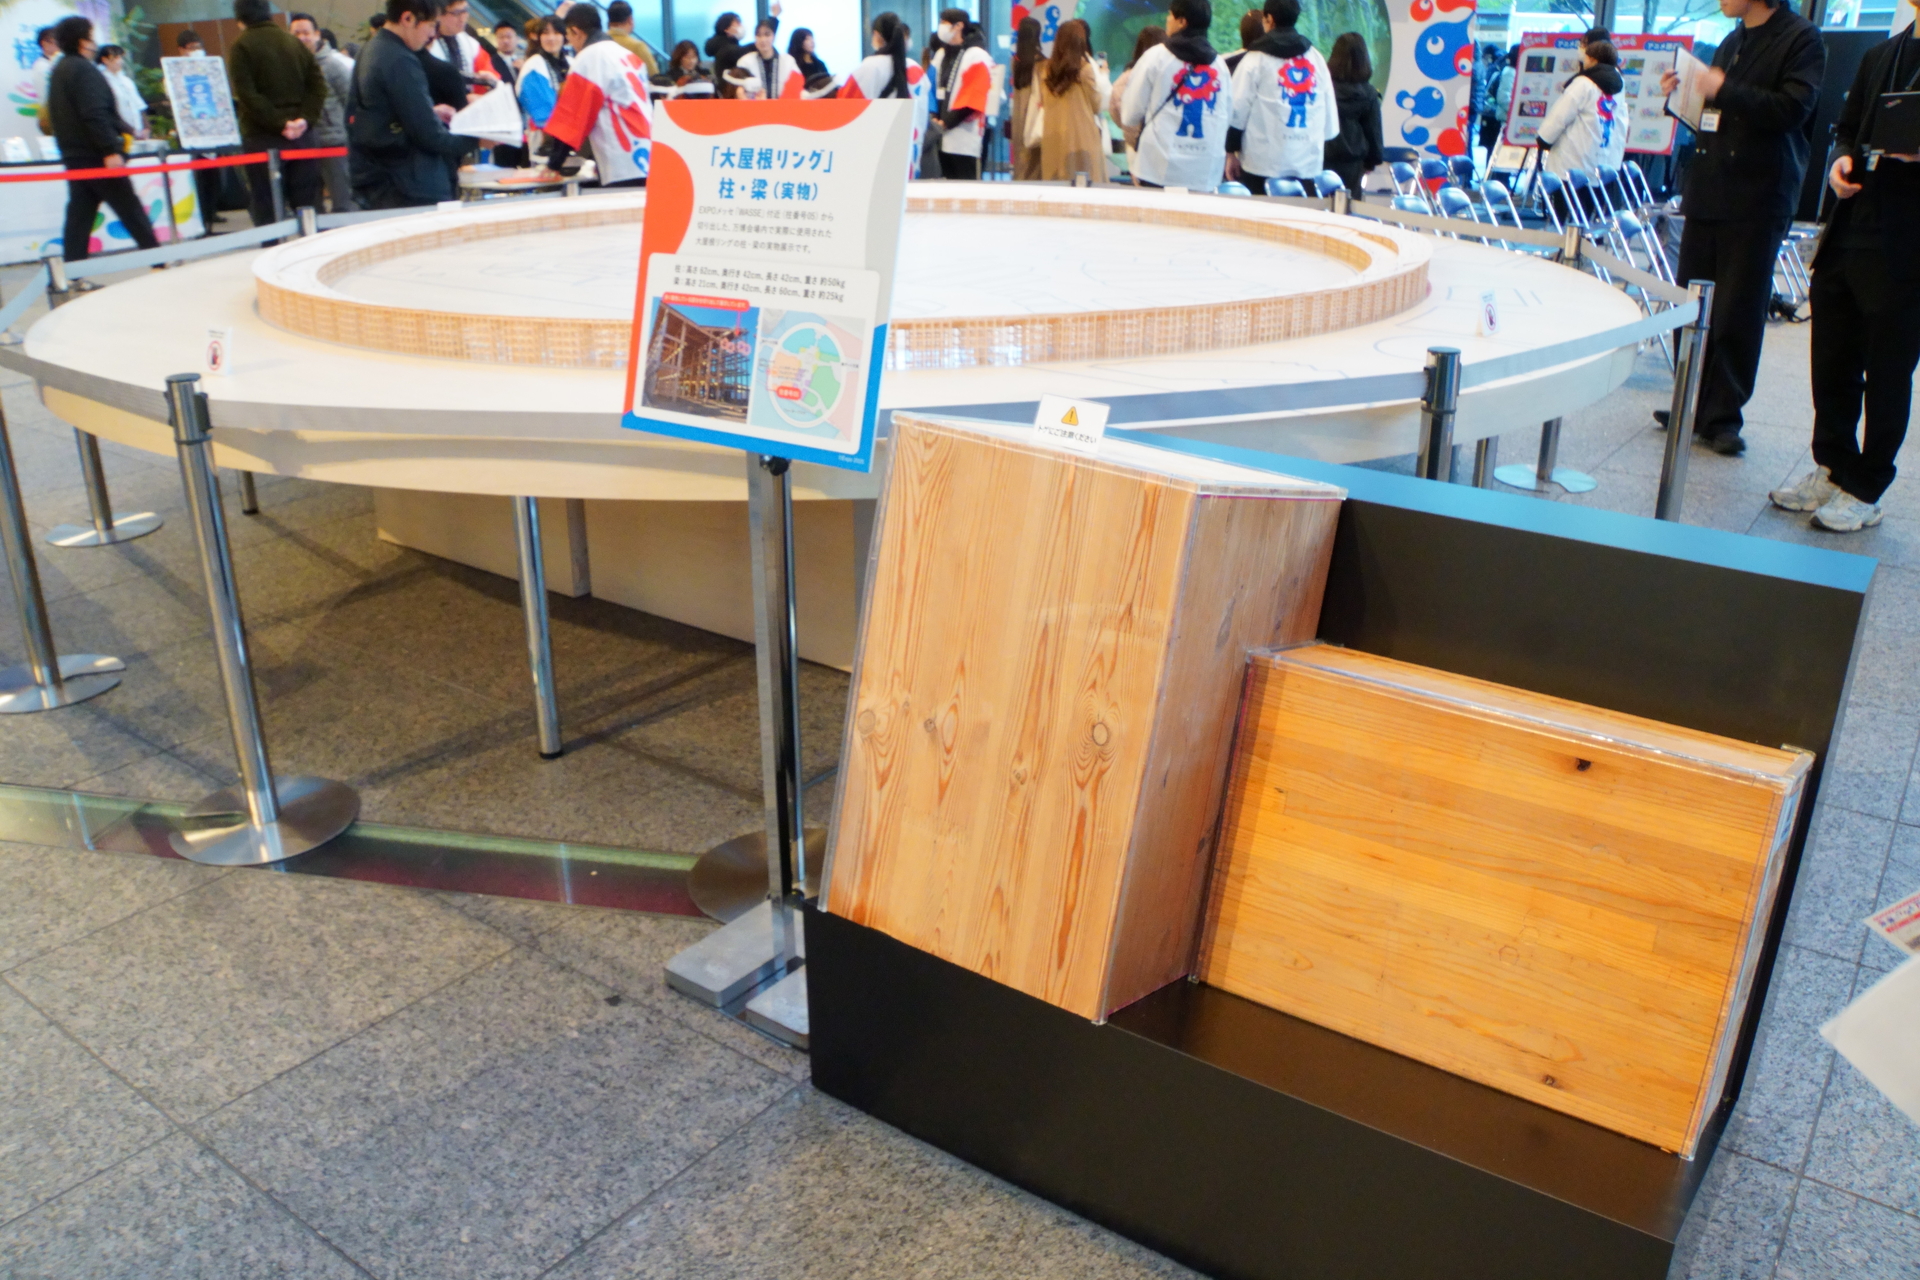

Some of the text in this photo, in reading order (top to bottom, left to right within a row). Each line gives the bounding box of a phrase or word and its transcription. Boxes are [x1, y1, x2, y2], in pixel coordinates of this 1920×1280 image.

[711, 146, 833, 173] 「大屋根リング」
[718, 177, 818, 201] 柱・梁（実物）
